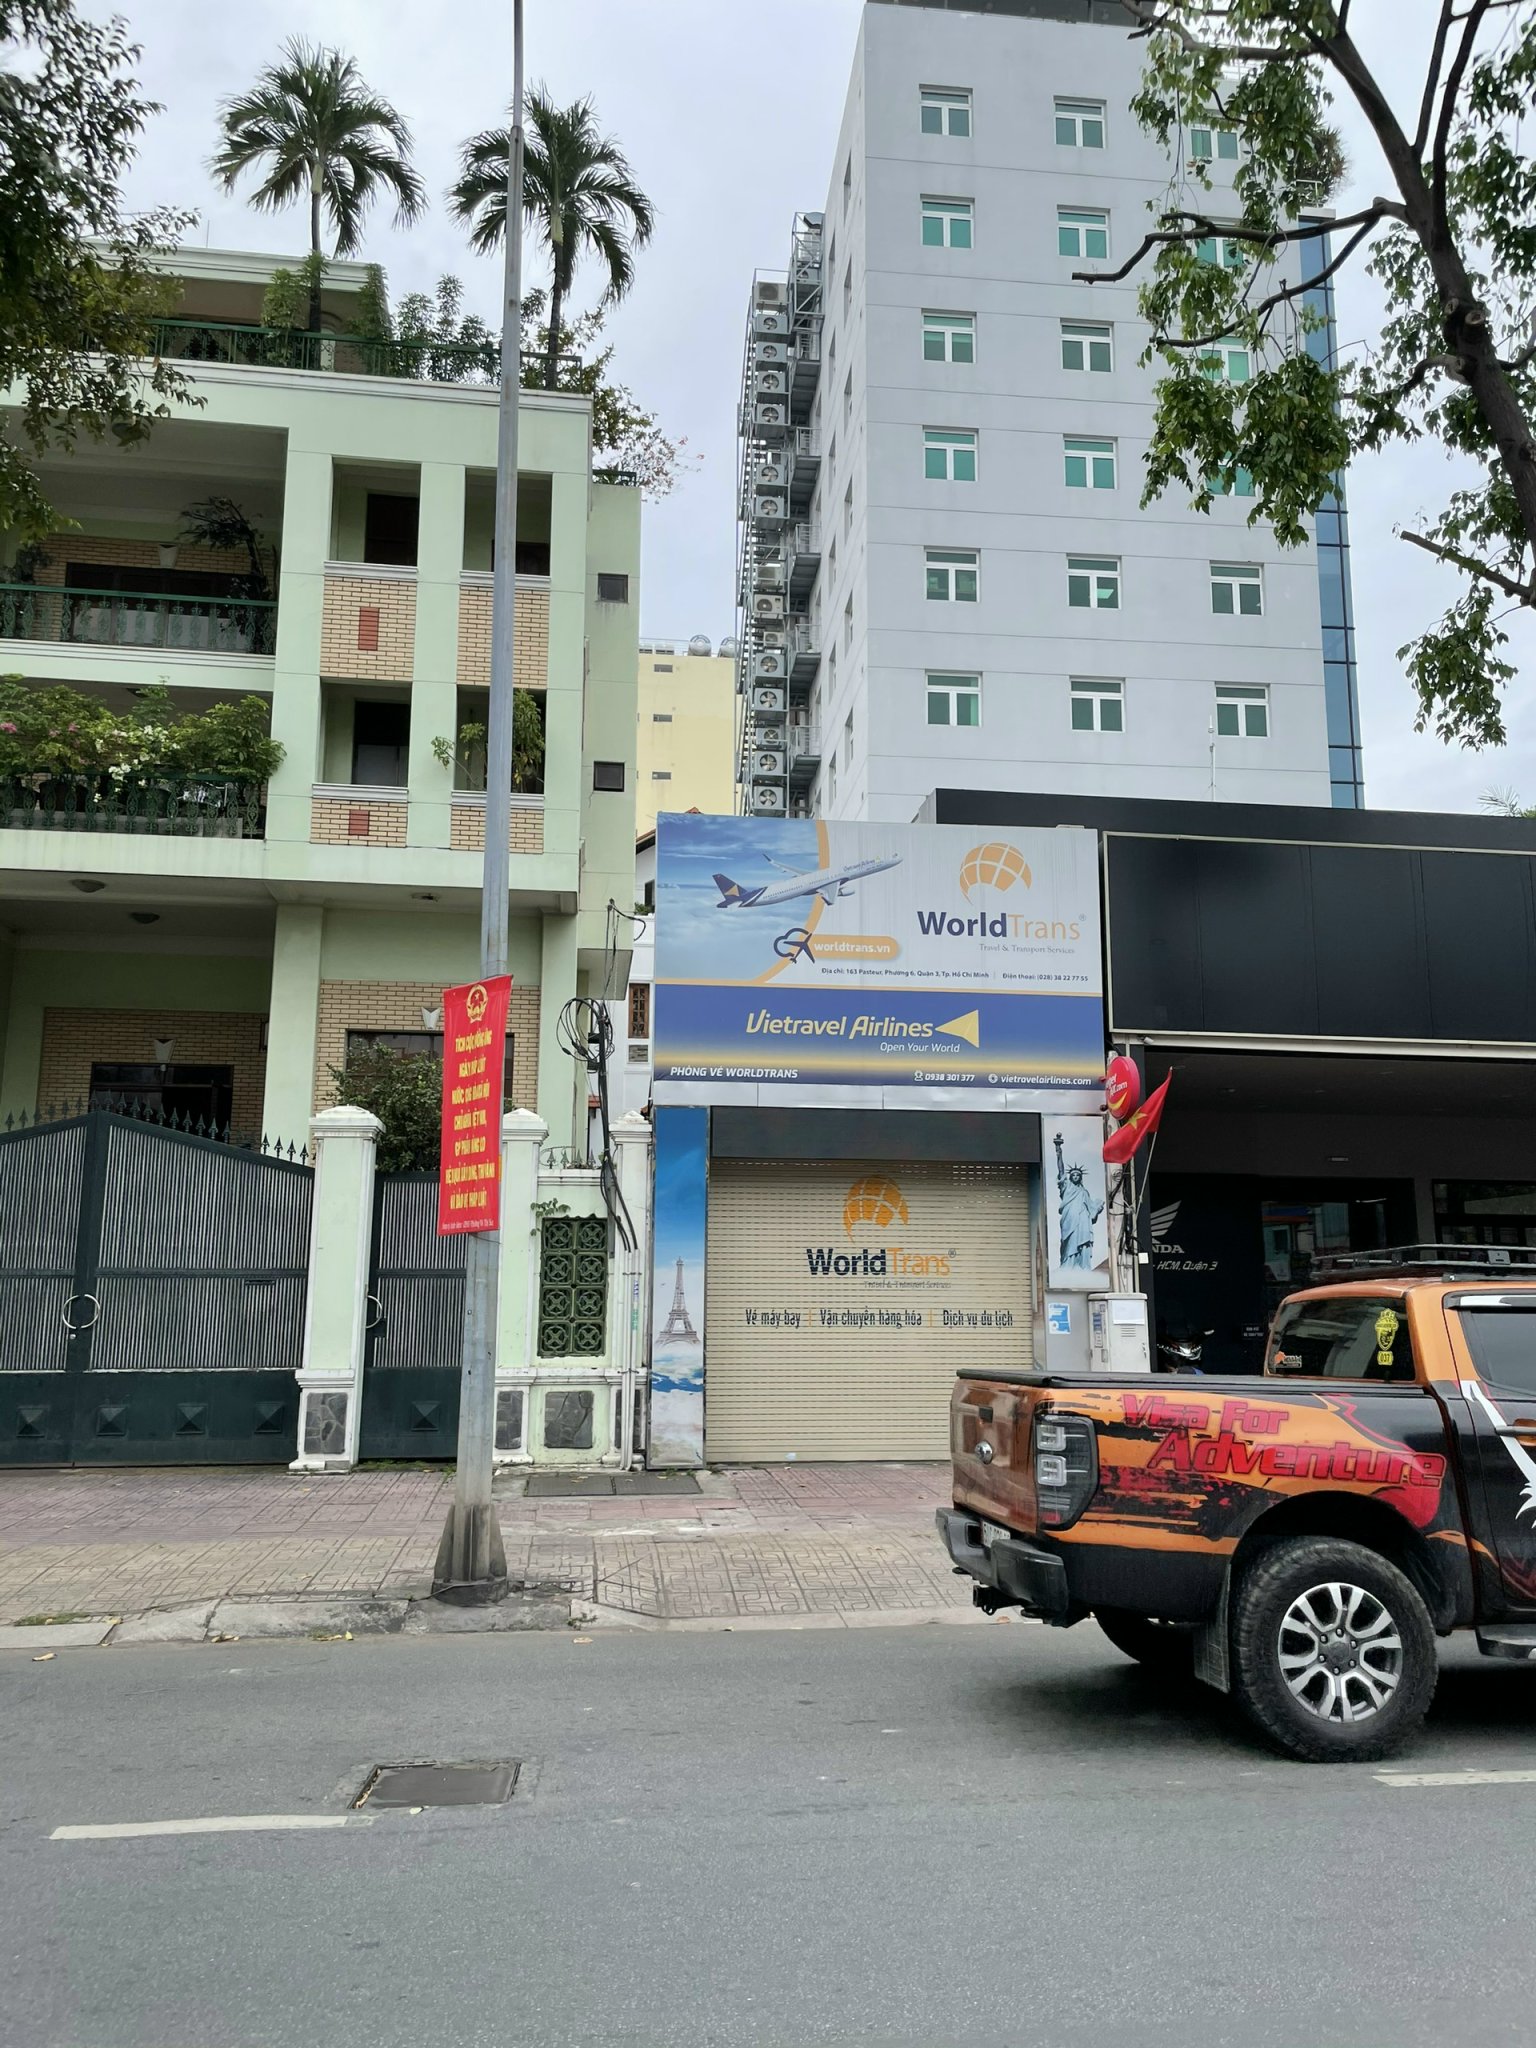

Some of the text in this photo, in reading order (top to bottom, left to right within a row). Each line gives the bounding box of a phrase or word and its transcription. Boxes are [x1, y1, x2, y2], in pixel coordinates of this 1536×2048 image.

[917, 911, 1080, 940] WorldTrans
[814, 941, 890, 953] worldtrans.vn
[979, 943, 1075, 954] Travel & Transport Services
[1037, 973, 1053, 981] (028)
[746, 1009, 934, 1039] Vietravel Airlines
[880, 1042, 961, 1053] Open Your World
[670, 1065, 798, 1079] PHÒNG VÉ WORLDTRANS
[925, 1073, 975, 1082] 0938 301 377
[1001, 1074, 1092, 1086] vietravelairlines.com
[1151, 1244, 1185, 1254] NDA
[806, 1247, 950, 1276] WorldTrans
[1209, 1261, 1218, 1270] 3
[745, 1308, 801, 1329] Vé máy bay
[820, 1309, 838, 1329] Vận
[879, 1309, 903, 1328] hàng
[904, 1309, 922, 1325] hóa
[943, 1309, 1013, 1330] Dịch vụ du lịch
[1121, 1393, 1289, 1434] Visa For
[1146, 1430, 1447, 1489] Adventure
